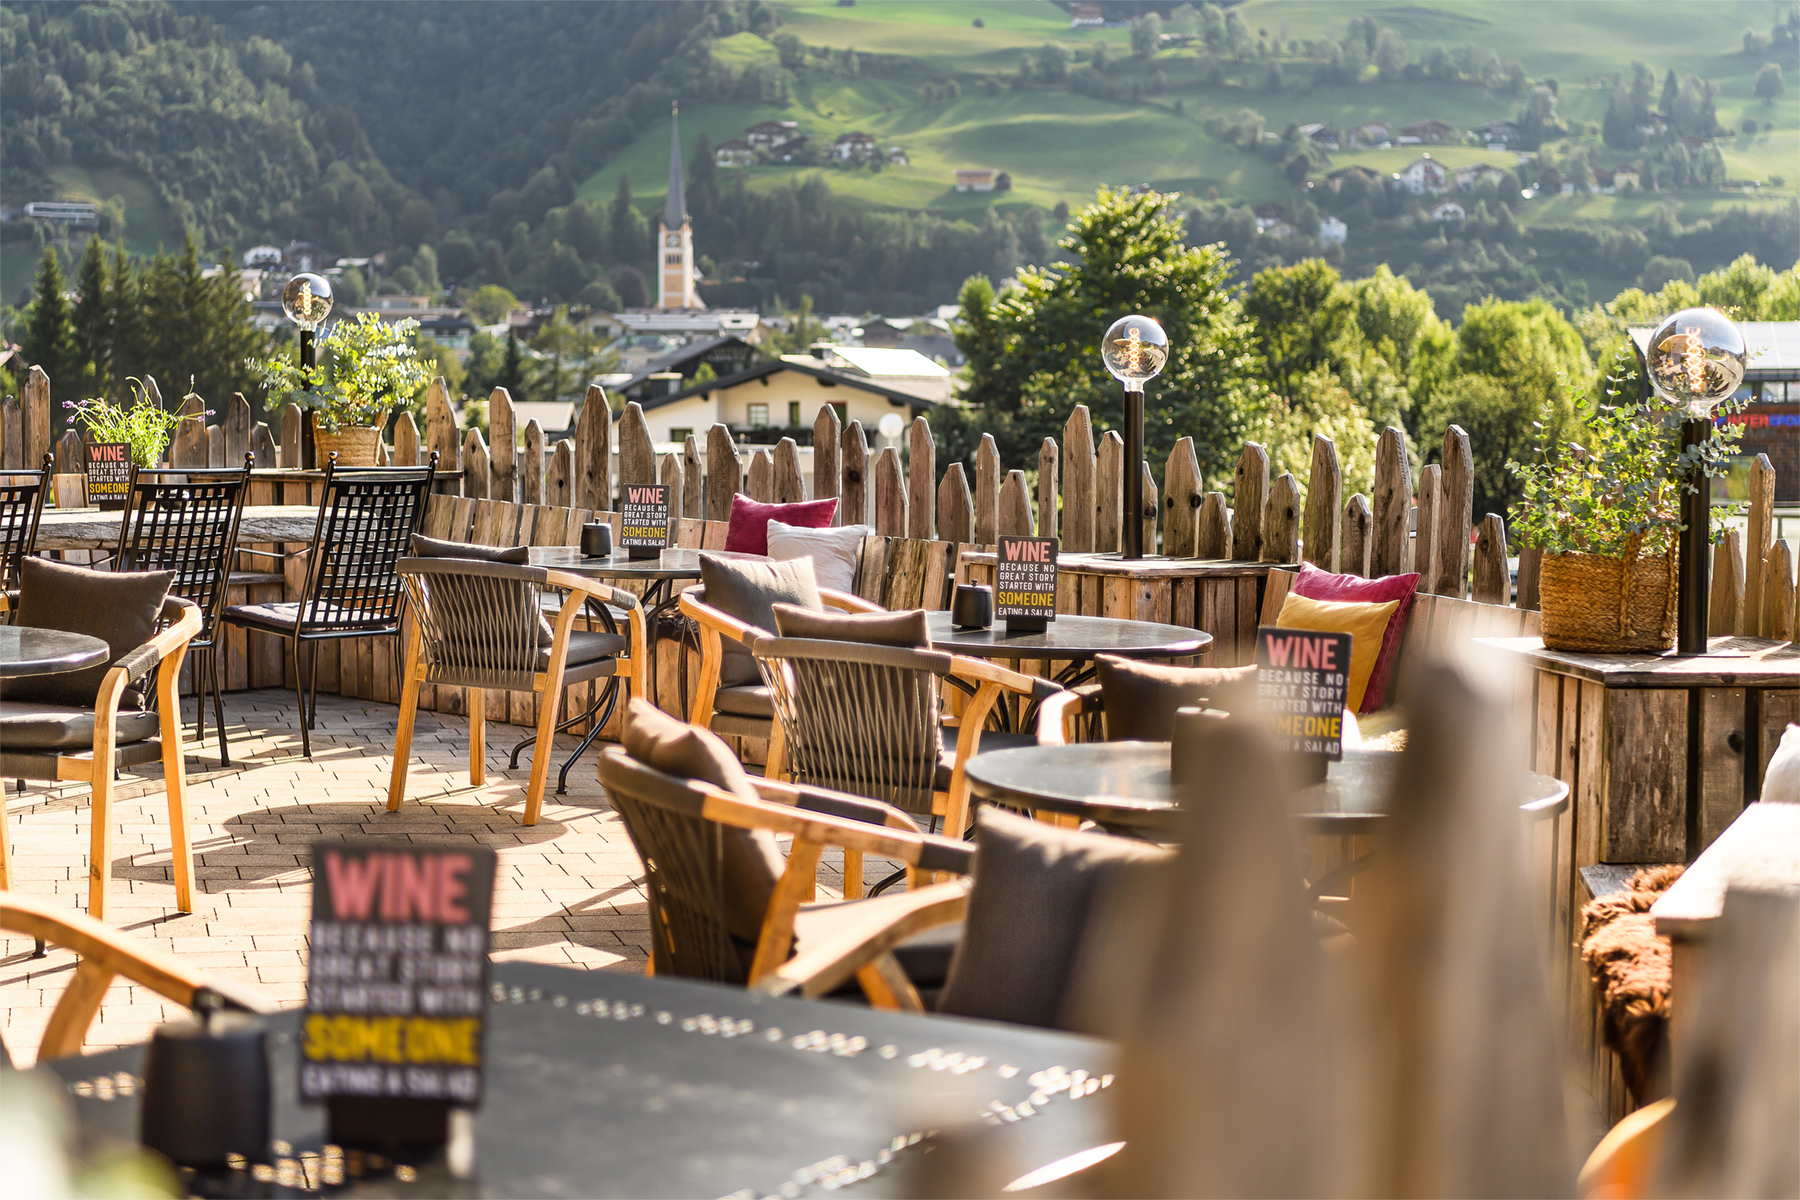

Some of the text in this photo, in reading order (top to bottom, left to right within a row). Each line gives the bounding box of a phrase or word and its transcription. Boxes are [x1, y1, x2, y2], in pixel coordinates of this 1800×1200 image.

[90, 446, 124, 461] WINE
[89, 483, 129, 493] SOMEONE
[628, 487, 664, 504] WINE
[623, 527, 665, 537] SOMEONE
[1005, 540, 1051, 562] WINE
[1000, 563, 1039, 572] BECAUSE
[1000, 572, 1054, 582] GREAT STORY
[1000, 582, 1054, 591] STARTED WITH
[999, 592, 1054, 606] SOMEONE
[1031, 609, 1053, 617] SALAD
[1266, 634, 1338, 670] WINE
[1259, 669, 1343, 686] BECAUSE NO
[1258, 684, 1343, 700] GREAT STORY
[1312, 701, 1342, 714] WITH
[323, 851, 474, 923] WINE
[312, 921, 485, 956] BECAUSE NO
[399, 956, 482, 986] STORY
[309, 983, 481, 1014] STARTED WITH
[303, 1014, 481, 1065] SOMEONE
[387, 1067, 403, 1094] A
